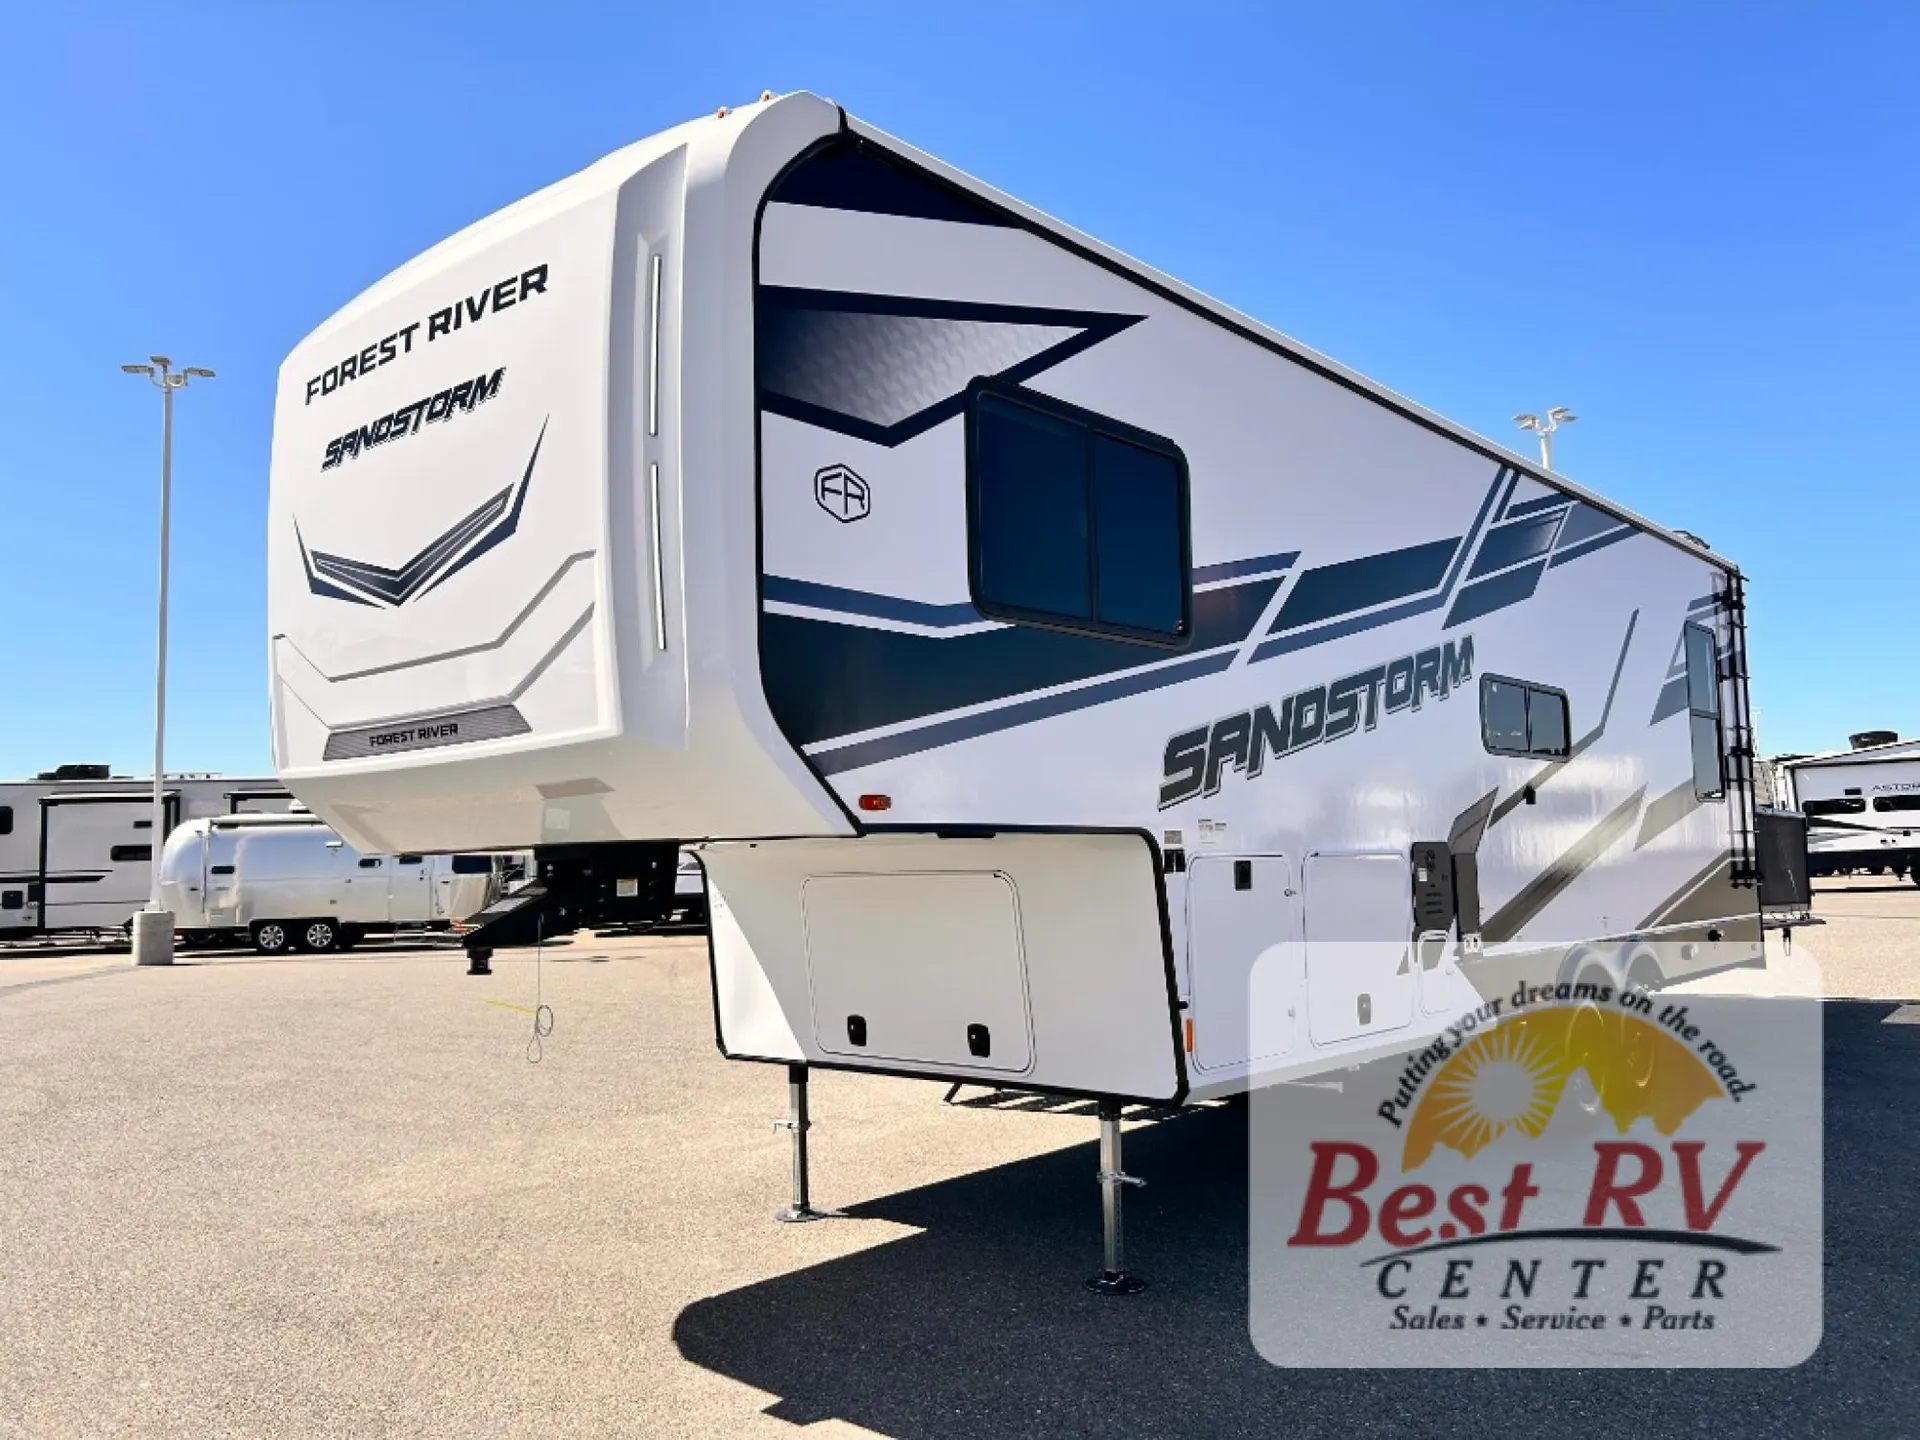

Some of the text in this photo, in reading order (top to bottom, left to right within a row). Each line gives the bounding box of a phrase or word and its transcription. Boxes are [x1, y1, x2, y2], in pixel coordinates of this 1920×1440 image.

[305, 263, 548, 405] FOREST RIVER
[320, 365, 507, 473] SANDSTORM
[369, 723, 459, 747] FOREST RIVER
[1157, 632, 1475, 812] SANDSTORM
